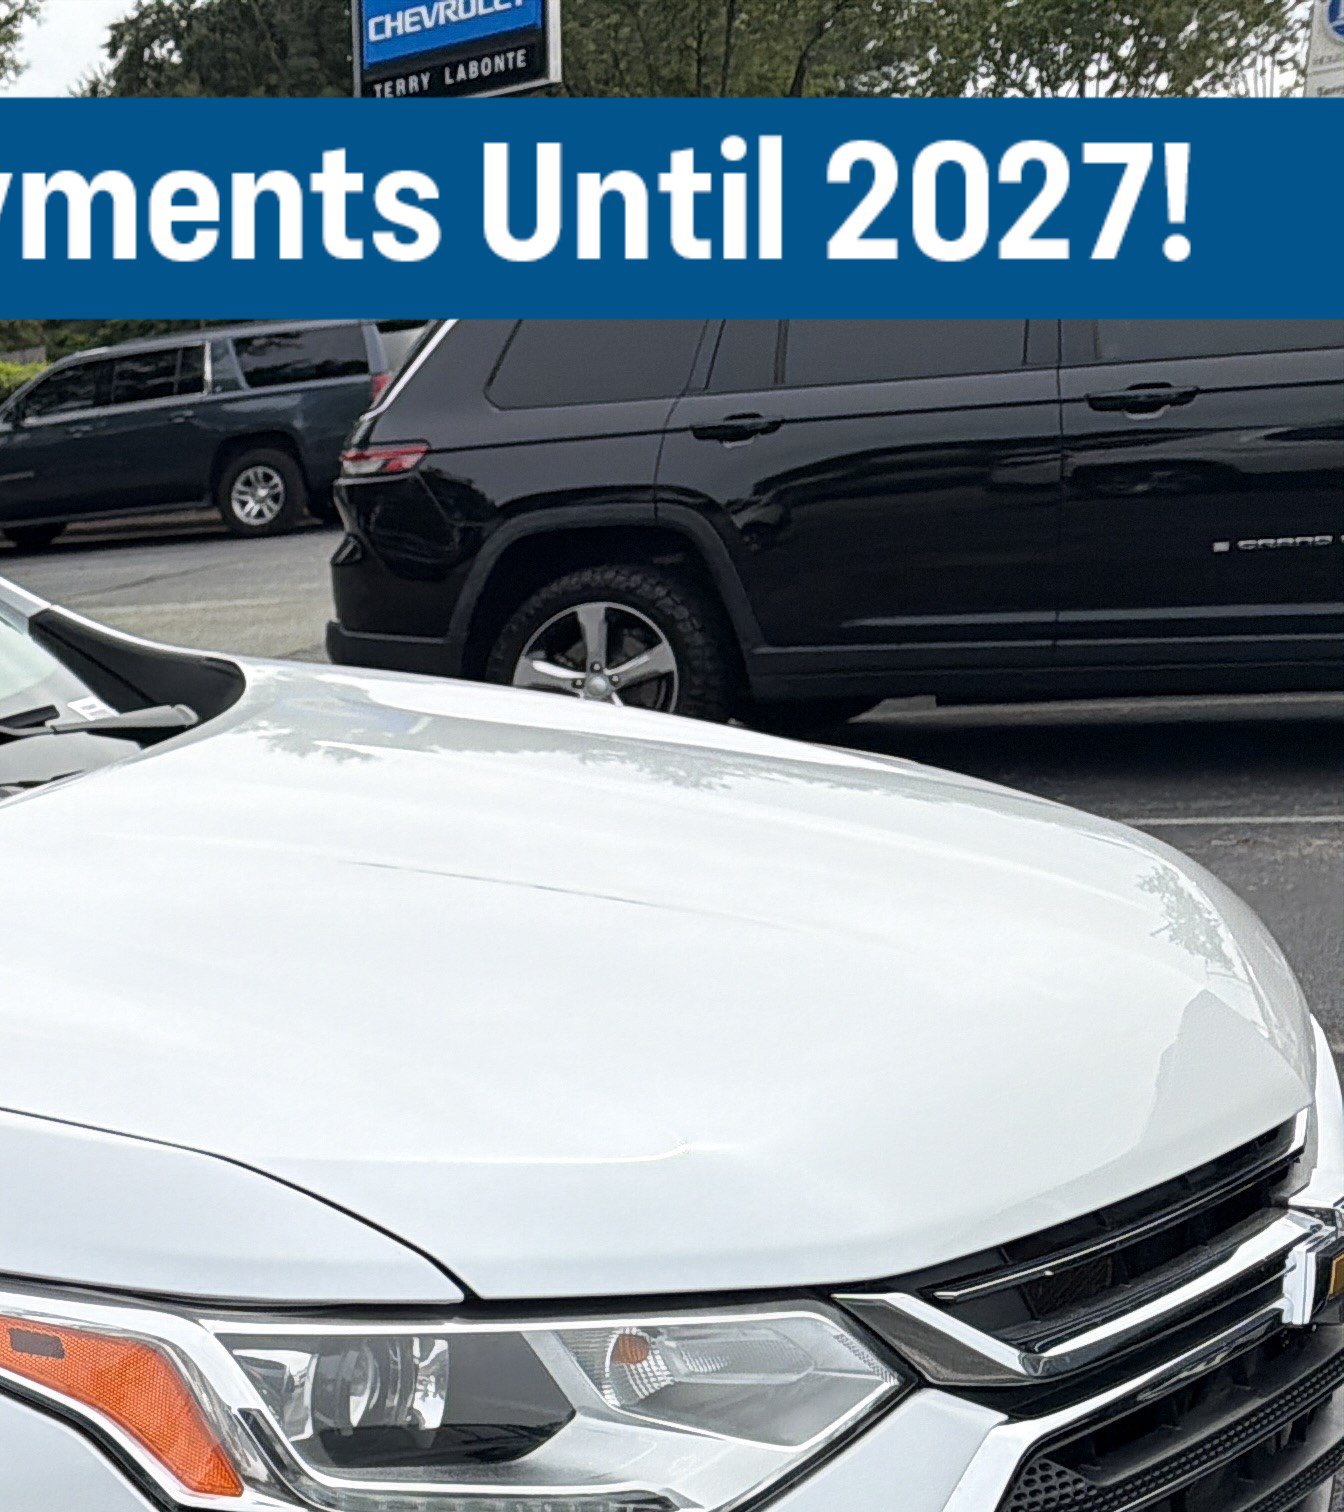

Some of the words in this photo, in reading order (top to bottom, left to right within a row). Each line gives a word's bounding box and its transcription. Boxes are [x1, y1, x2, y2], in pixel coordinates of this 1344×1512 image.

[368, 0, 523, 42] CHEVROLE
[374, 72, 431, 98] TERRY
[444, 48, 527, 85] LABONTE
